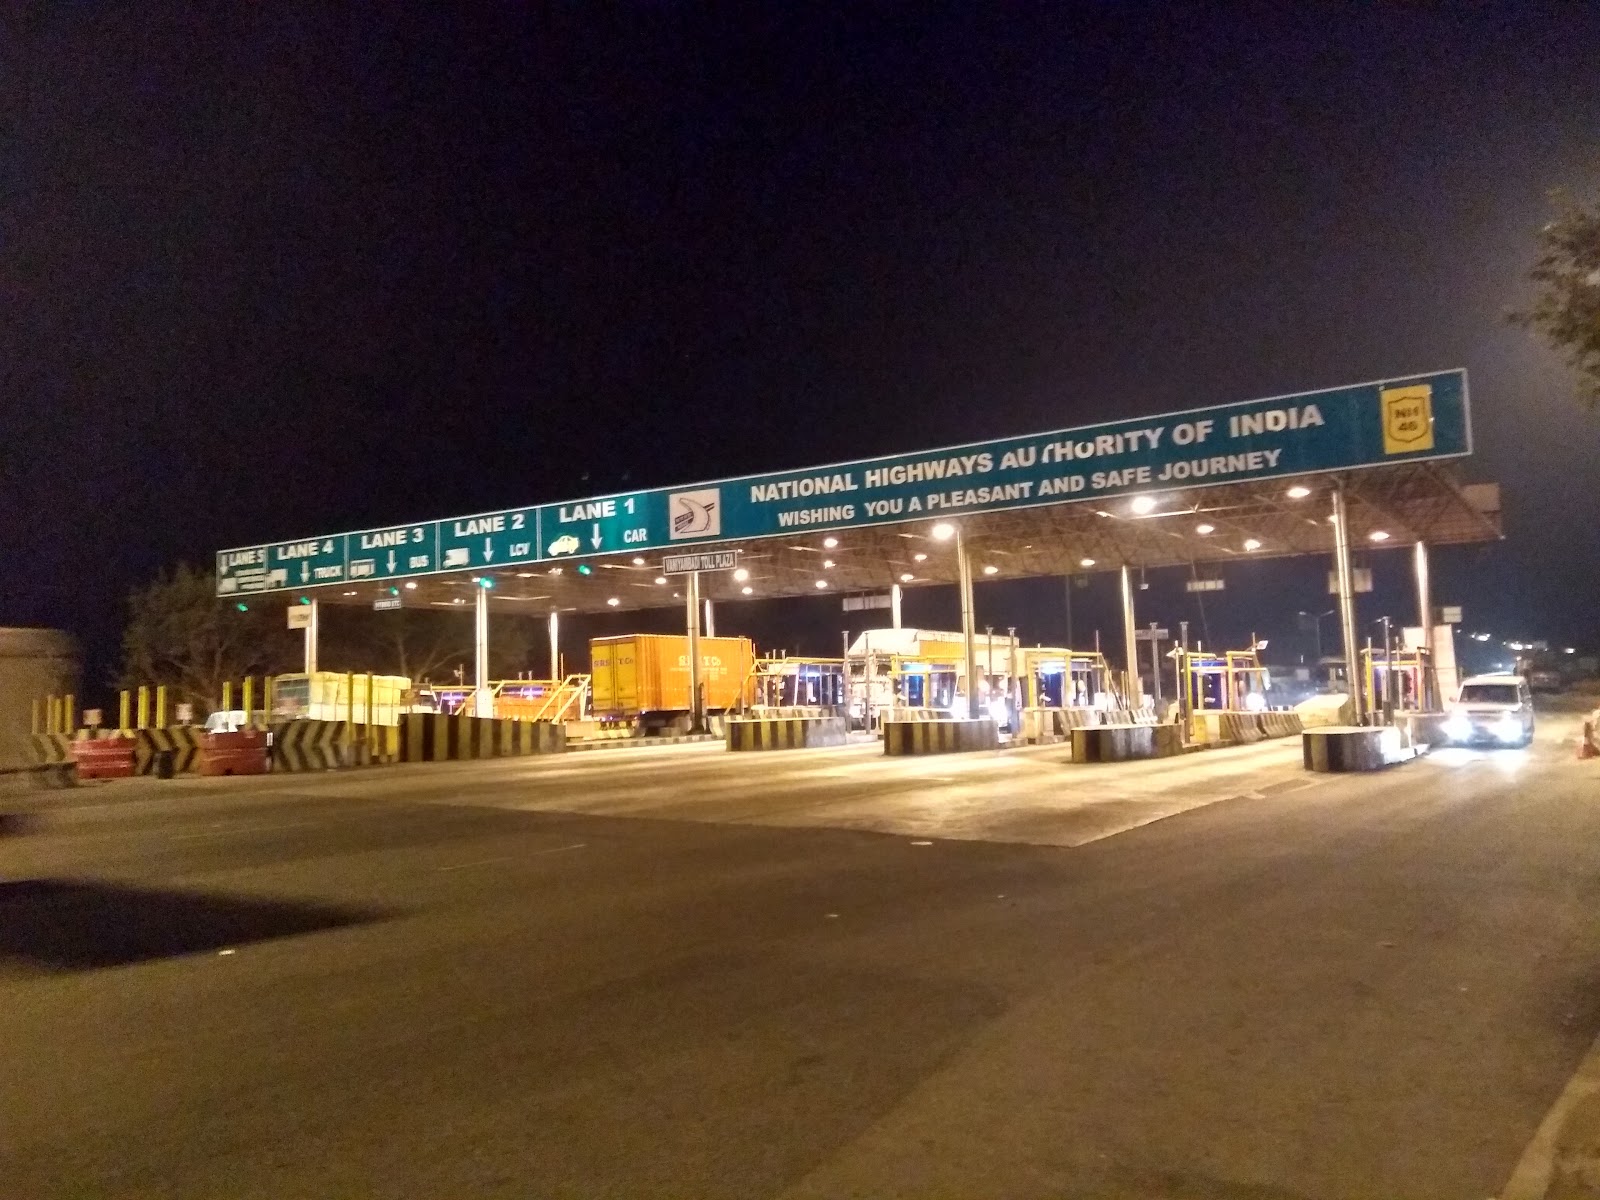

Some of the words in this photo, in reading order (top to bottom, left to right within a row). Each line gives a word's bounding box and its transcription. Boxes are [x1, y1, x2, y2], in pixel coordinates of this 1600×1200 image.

[751, 473, 858, 503] NATIONAL
[865, 452, 994, 489] HIGHWAYS
[1172, 419, 1214, 446] OF
[1229, 404, 1325, 438] INDIA
[778, 504, 856, 527] WISHING
[864, 497, 903, 518] YOU
[908, 495, 922, 512] A
[927, 481, 1034, 511] PLEASANT
[1038, 474, 1085, 497] AND
[1091, 465, 1151, 490] SAFE
[1158, 448, 1282, 481] JOURNEY
[558, 500, 616, 523] LANE
[623, 497, 636, 515] 1
[454, 516, 506, 538] LANE
[511, 514, 526, 530] 2
[623, 528, 647, 544] CAR
[361, 529, 408, 550] LANE
[412, 527, 424, 543] 3
[228, 550, 257, 567] LANE
[277, 541, 319, 561] LANE
[322, 539, 334, 554] 4
[509, 542, 531, 558] LCV
[715, 552, 734, 568] PLAZA
